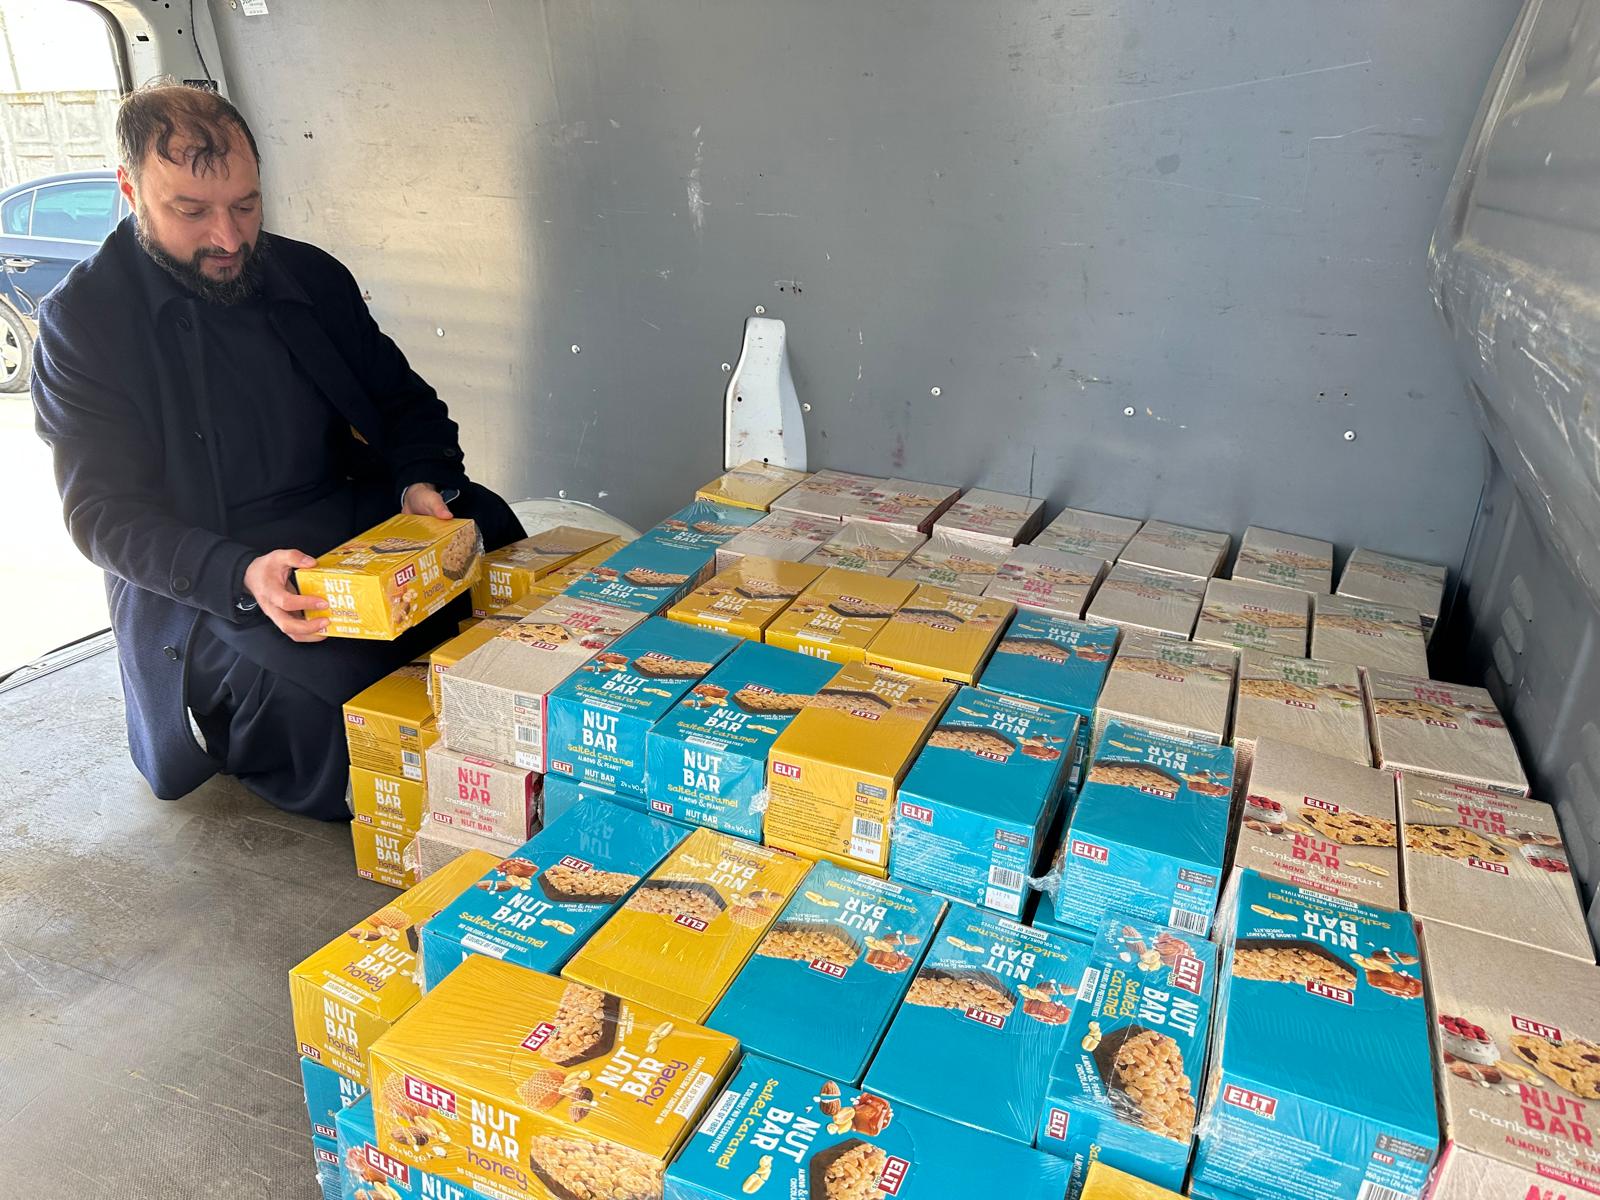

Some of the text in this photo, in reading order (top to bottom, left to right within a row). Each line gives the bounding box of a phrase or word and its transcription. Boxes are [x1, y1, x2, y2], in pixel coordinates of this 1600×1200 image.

[418, 550, 438, 570] NUT
[323, 578, 352, 593] NUT
[421, 565, 440, 586] BAR
[489, 570, 512, 586] NUT
[489, 584, 512, 599] BAR
[600, 588, 631, 599] BAR
[607, 583, 638, 593] NUT
[327, 594, 356, 609] BAR
[713, 601, 744, 612] BAR
[720, 595, 752, 606] NUT
[809, 619, 841, 630] BAR
[816, 612, 849, 624] NUT
[601, 680, 639, 696] BAR
[611, 673, 650, 687] NUT
[873, 679, 910, 693] BAR
[867, 686, 904, 699] NUT
[583, 709, 619, 734] NUT
[704, 717, 742, 733] BAR
[713, 708, 752, 723] NUT
[993, 712, 1030, 729] BAR
[987, 719, 1027, 736] NUT
[582, 728, 617, 754] BAR
[684, 749, 722, 775] NUT
[1144, 757, 1186, 771] NUT
[1148, 745, 1188, 763] BAR
[374, 778, 400, 794] NUT
[457, 766, 491, 789] NUT
[584, 768, 615, 783] NUT BAR
[683, 768, 721, 795] BAR
[376, 792, 401, 809] BAR
[457, 783, 491, 807] BAR
[461, 818, 493, 833] NUT BAR
[686, 808, 718, 823] NUT BAR
[1457, 804, 1506, 824] BAR
[1458, 815, 1507, 835] NUT
[375, 834, 400, 851] NUT
[1293, 833, 1342, 857] NUT
[376, 848, 401, 864] BAR
[1251, 845, 1384, 889] cranberry yogurt
[1273, 860, 1305, 875] ALMOND
[1292, 846, 1341, 870] BAR
[705, 869, 749, 891] NUT
[716, 858, 757, 879] BAR
[507, 892, 554, 917] NUT
[844, 896, 888, 920] BAR
[491, 906, 537, 931] BAR
[834, 909, 881, 934] NUT
[1303, 910, 1358, 936] BAR
[1301, 924, 1358, 950] NUT
[372, 942, 415, 966] NUT
[990, 942, 1036, 968] BAR
[343, 962, 387, 993] honey
[356, 954, 398, 980] BAR
[982, 955, 1031, 981] NUT
[1102, 969, 1126, 1019] caramel
[1137, 986, 1170, 1025] BAR
[323, 996, 357, 1029] NUT
[1168, 996, 1199, 1037] NUT
[324, 1015, 359, 1049] BAR
[327, 1033, 361, 1062] honey
[332, 1057, 361, 1078] NUT BAR
[596, 1045, 640, 1089] NUT
[620, 1057, 665, 1098] BAR
[635, 1059, 689, 1107] honey
[1519, 1083, 1586, 1123] NUT
[471, 1098, 520, 1137] NUT
[749, 1106, 795, 1151] BAR
[1520, 1105, 1594, 1147] BAR
[470, 1122, 520, 1162] BAR
[715, 1117, 755, 1170] caramel
[778, 1116, 821, 1164] NUT
[1468, 1107, 1579, 1157] cranberry
[1505, 1135, 1551, 1157] ALMOND
[466, 1146, 528, 1191] honey
